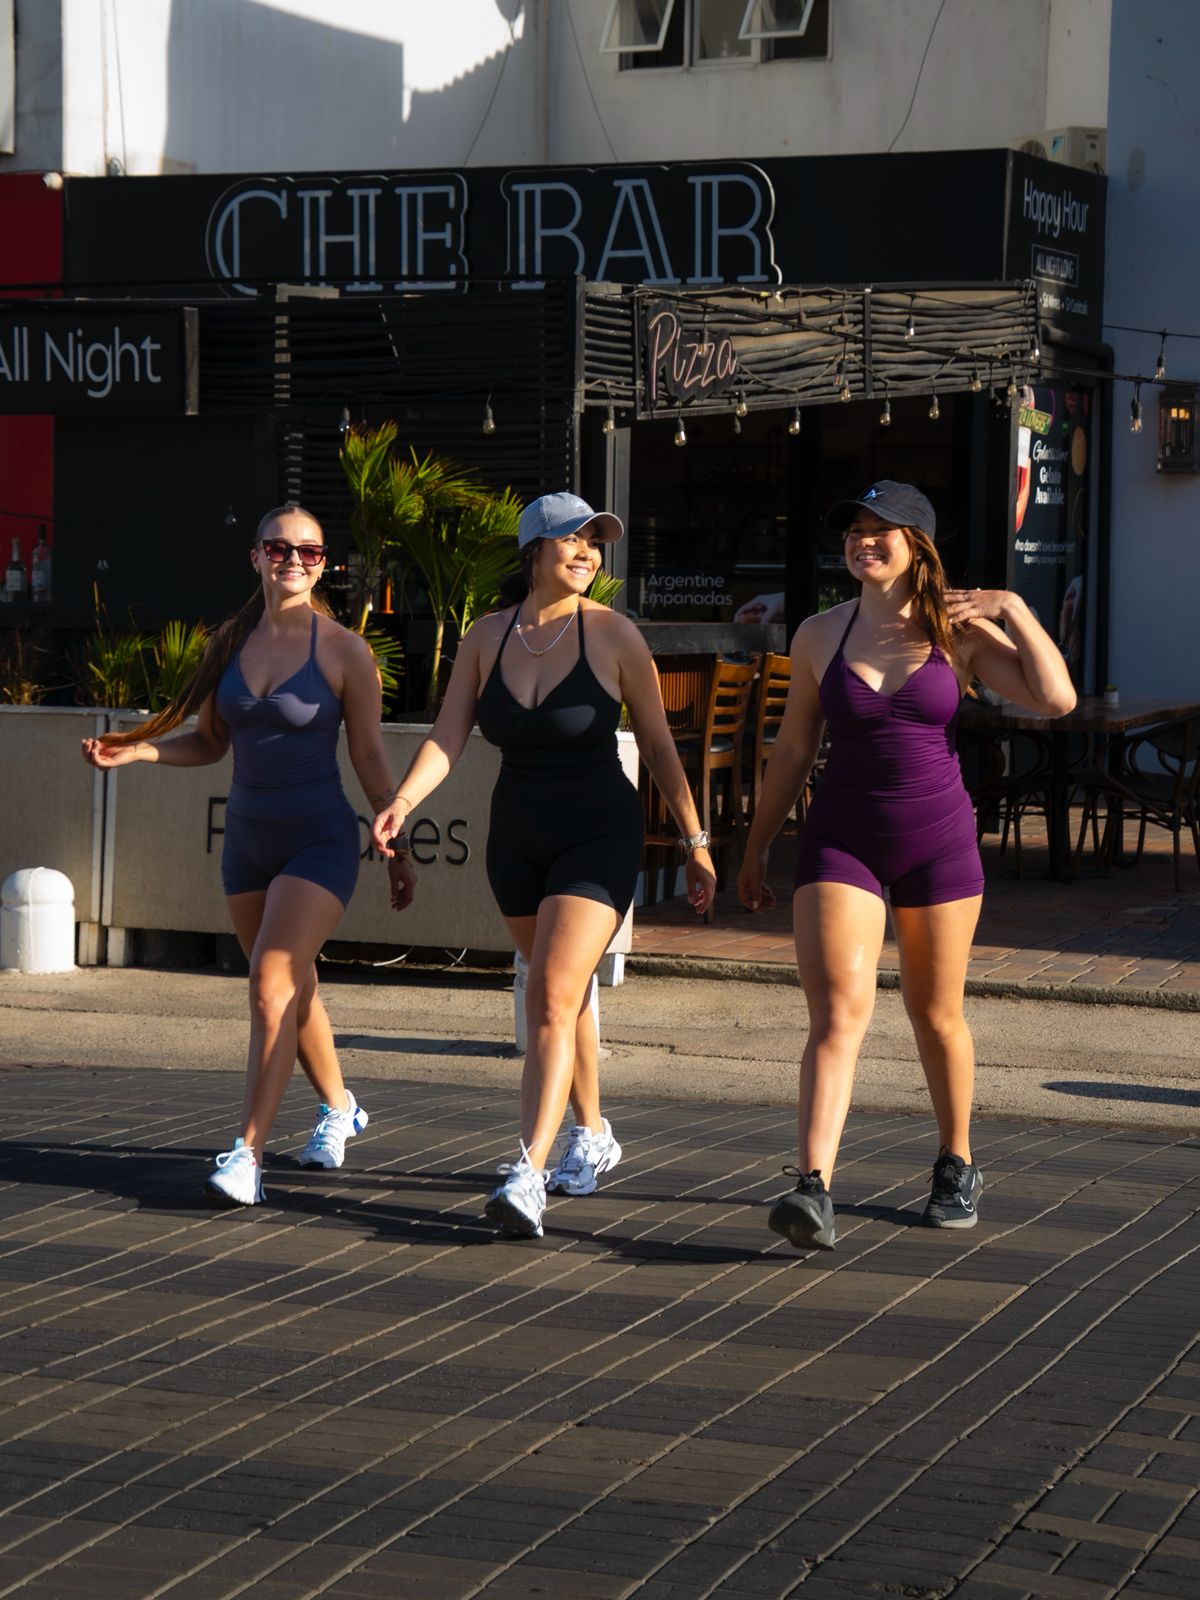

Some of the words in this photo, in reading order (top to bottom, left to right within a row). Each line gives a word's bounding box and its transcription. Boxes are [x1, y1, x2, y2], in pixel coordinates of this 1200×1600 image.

[215, 185, 456, 295] CHE
[511, 174, 769, 290] BAR
[1023, 178, 1061, 238] Happy
[1062, 190, 1089, 233] Hour
[45, 326, 161, 398] Night
[648, 312, 738, 400] Pizza
[640, 591, 733, 608] Empanadas
[648, 573, 725, 590] Argentine
